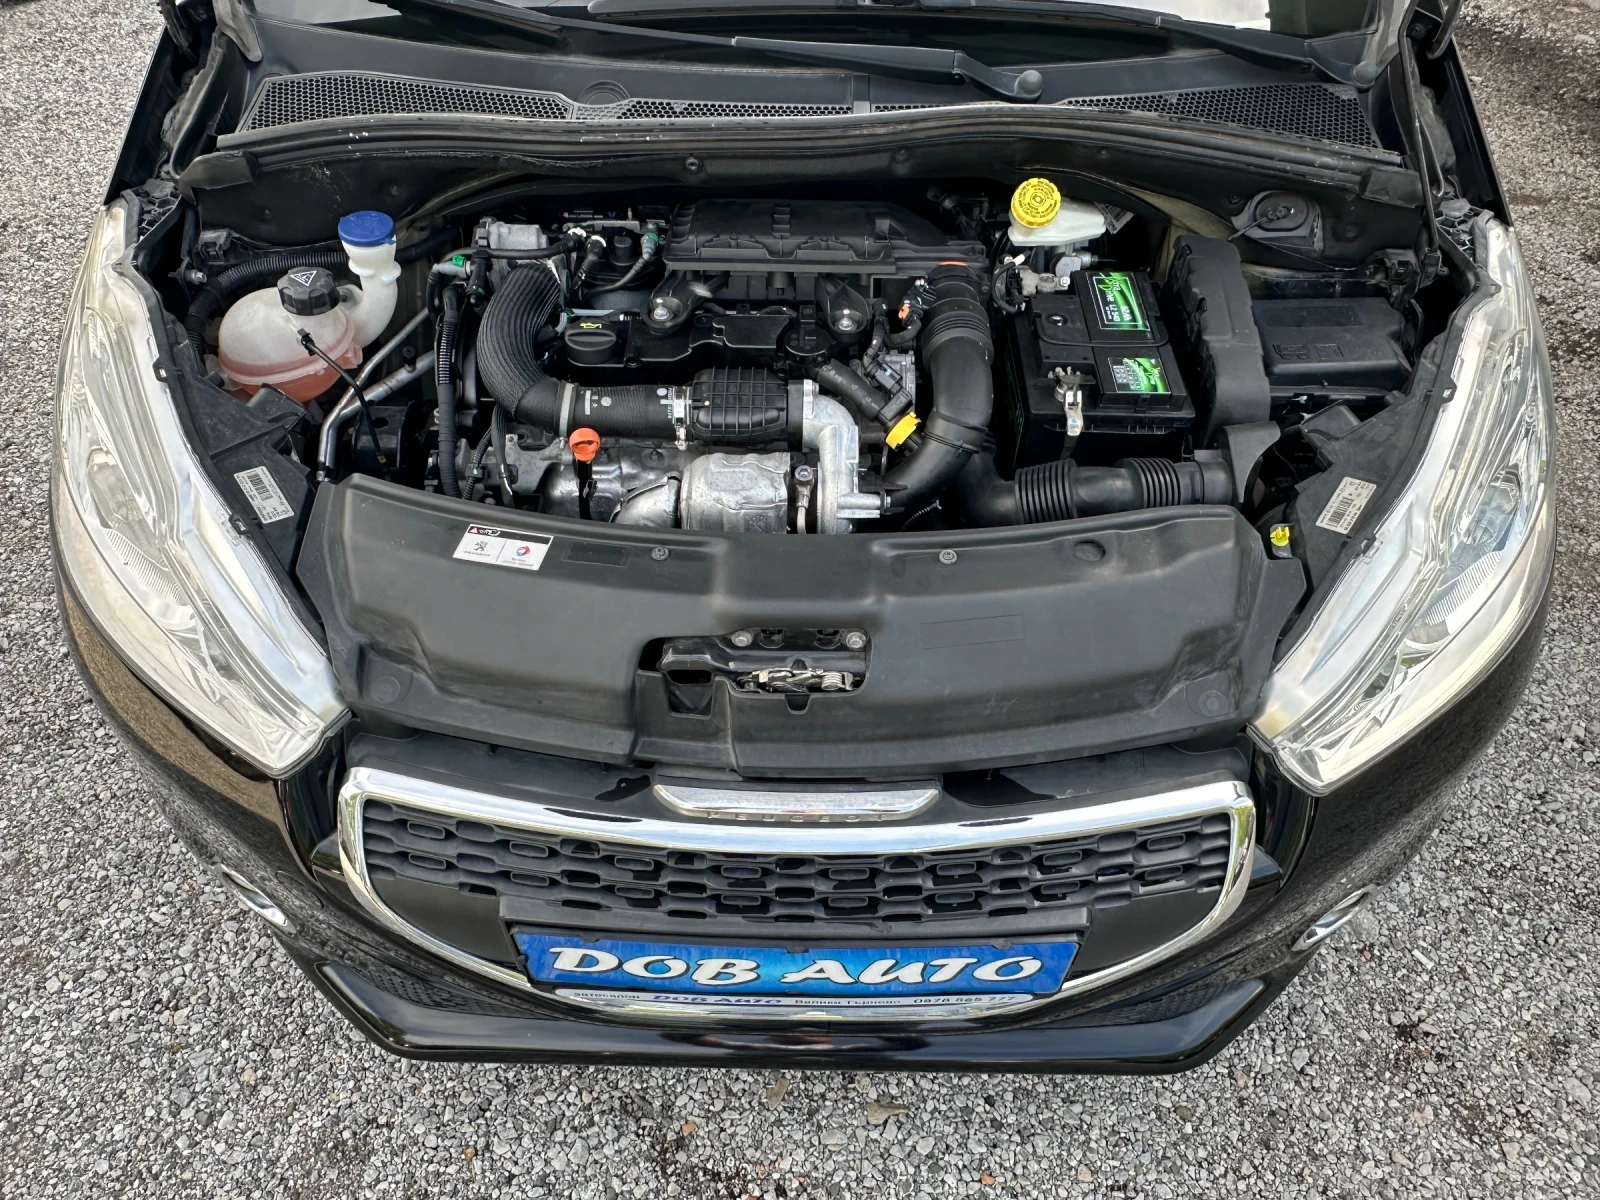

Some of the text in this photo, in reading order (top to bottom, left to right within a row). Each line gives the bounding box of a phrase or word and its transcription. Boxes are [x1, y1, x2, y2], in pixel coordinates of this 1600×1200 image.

[707, 811, 883, 823] PEUGEOT
[549, 947, 1044, 985] DOB AUTO
